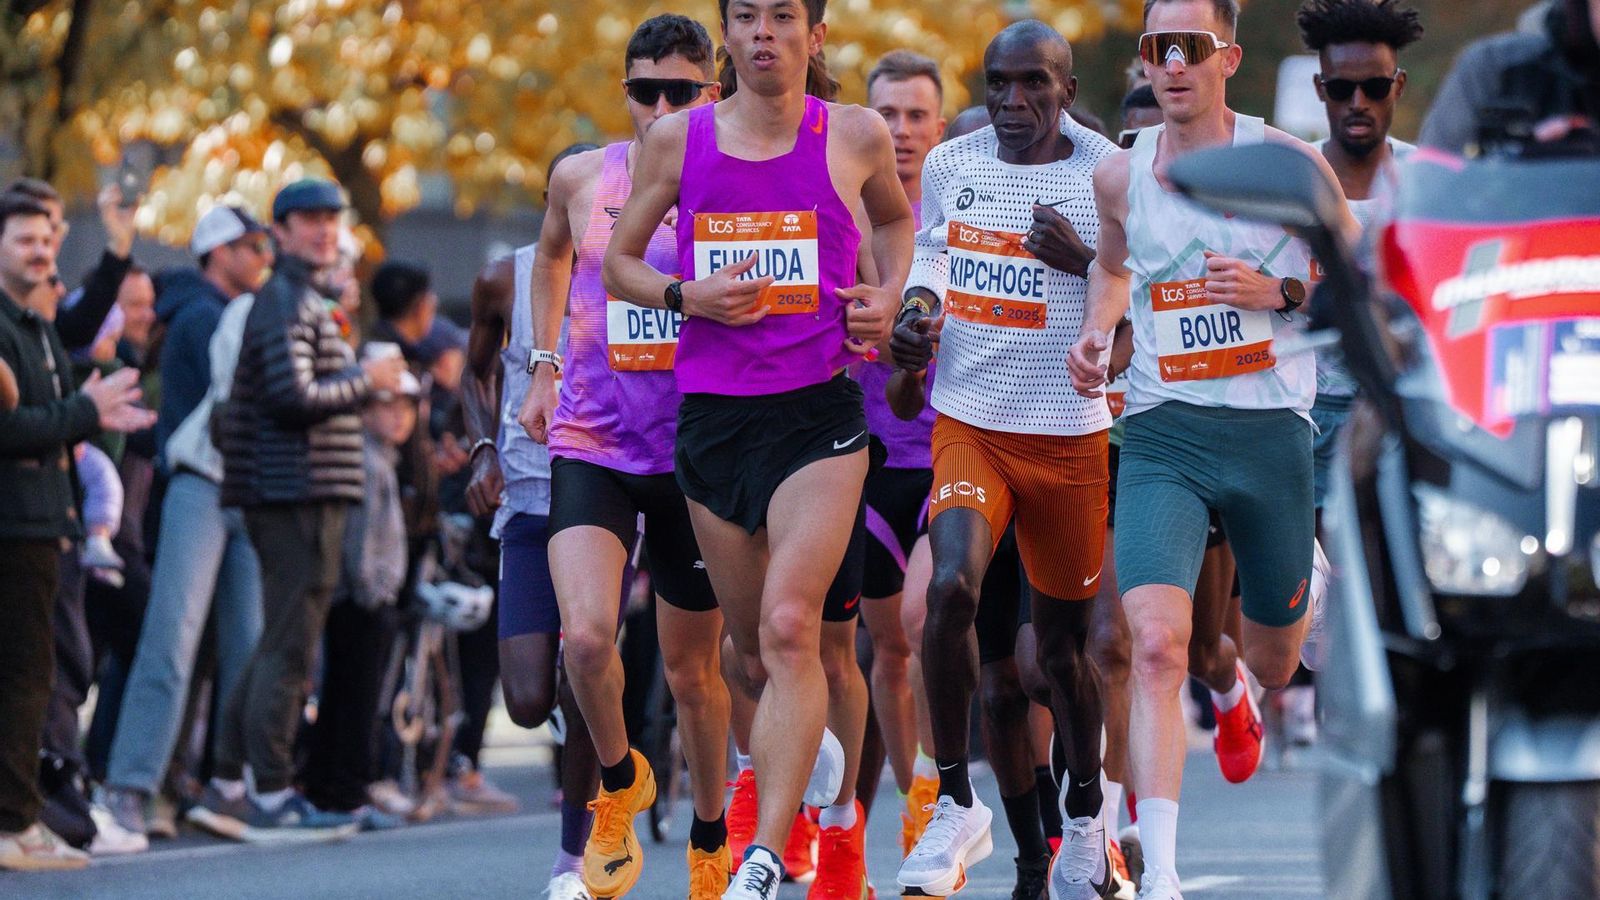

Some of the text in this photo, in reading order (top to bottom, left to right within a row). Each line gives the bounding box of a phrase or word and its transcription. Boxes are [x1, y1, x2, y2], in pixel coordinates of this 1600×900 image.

[708, 217, 734, 233] tcs
[960, 225, 980, 243] tcs
[950, 255, 1045, 298] KIPCHOGE
[777, 293, 813, 305] 2025
[1161, 286, 1185, 302] tcs
[1008, 308, 1040, 321] 2025
[1179, 310, 1245, 349] BOUR
[1236, 350, 1270, 366] 2025
